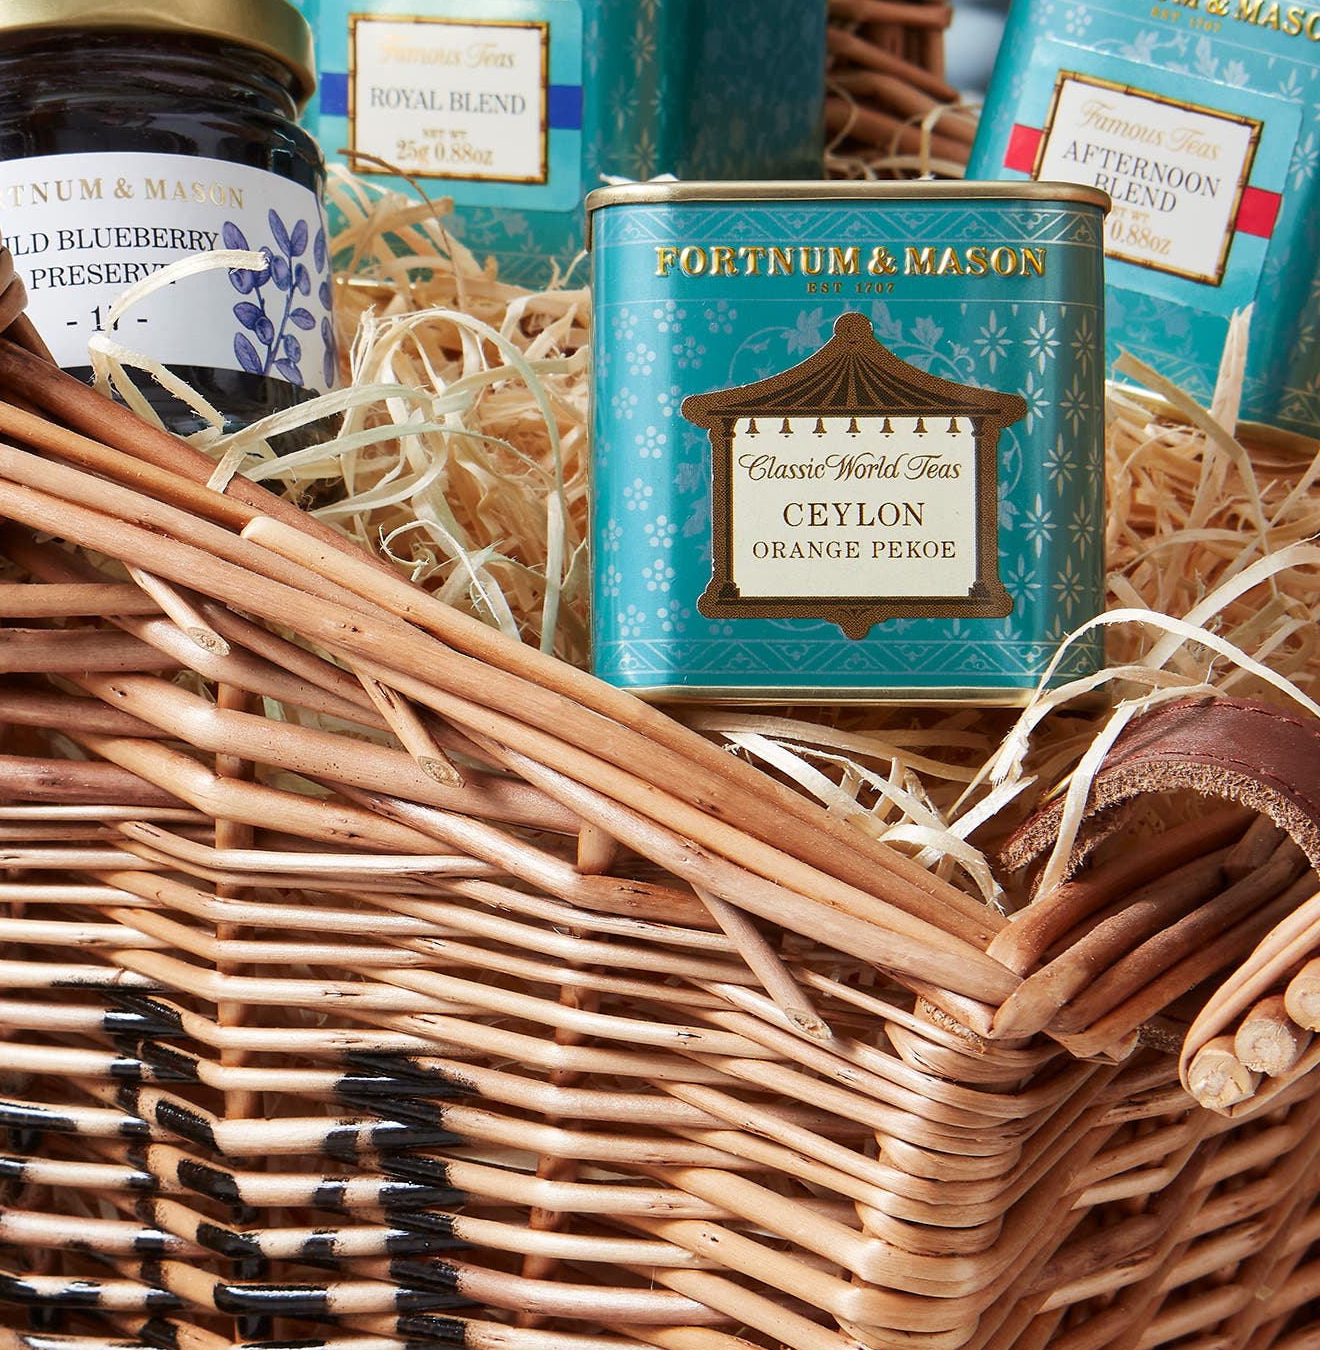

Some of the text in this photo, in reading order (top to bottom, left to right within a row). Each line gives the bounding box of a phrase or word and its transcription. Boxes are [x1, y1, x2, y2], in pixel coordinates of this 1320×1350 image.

[1151, 6, 1221, 33] EST 1707
[377, 35, 516, 69] Famous Teas
[370, 86, 526, 115] ROYAL BLEND
[1077, 99, 1222, 161] Famous Teas
[396, 139, 493, 166] 25g 0.88oz
[1062, 139, 1222, 199] AFTERNOON
[113, 177, 135, 199] &
[144, 178, 246, 211] MASON
[1094, 172, 1177, 213] BLEND
[1, 227, 220, 257] ILD BLUEBERRY
[1110, 218, 1173, 256] 0.88oz
[654, 245, 1048, 278] FORTNUM & MASON
[806, 282, 896, 294] EST 1707
[738, 452, 962, 481] Classic World Teas
[782, 502, 925, 527] CEYLON
[752, 540, 956, 559] ORANGE PEKOE
